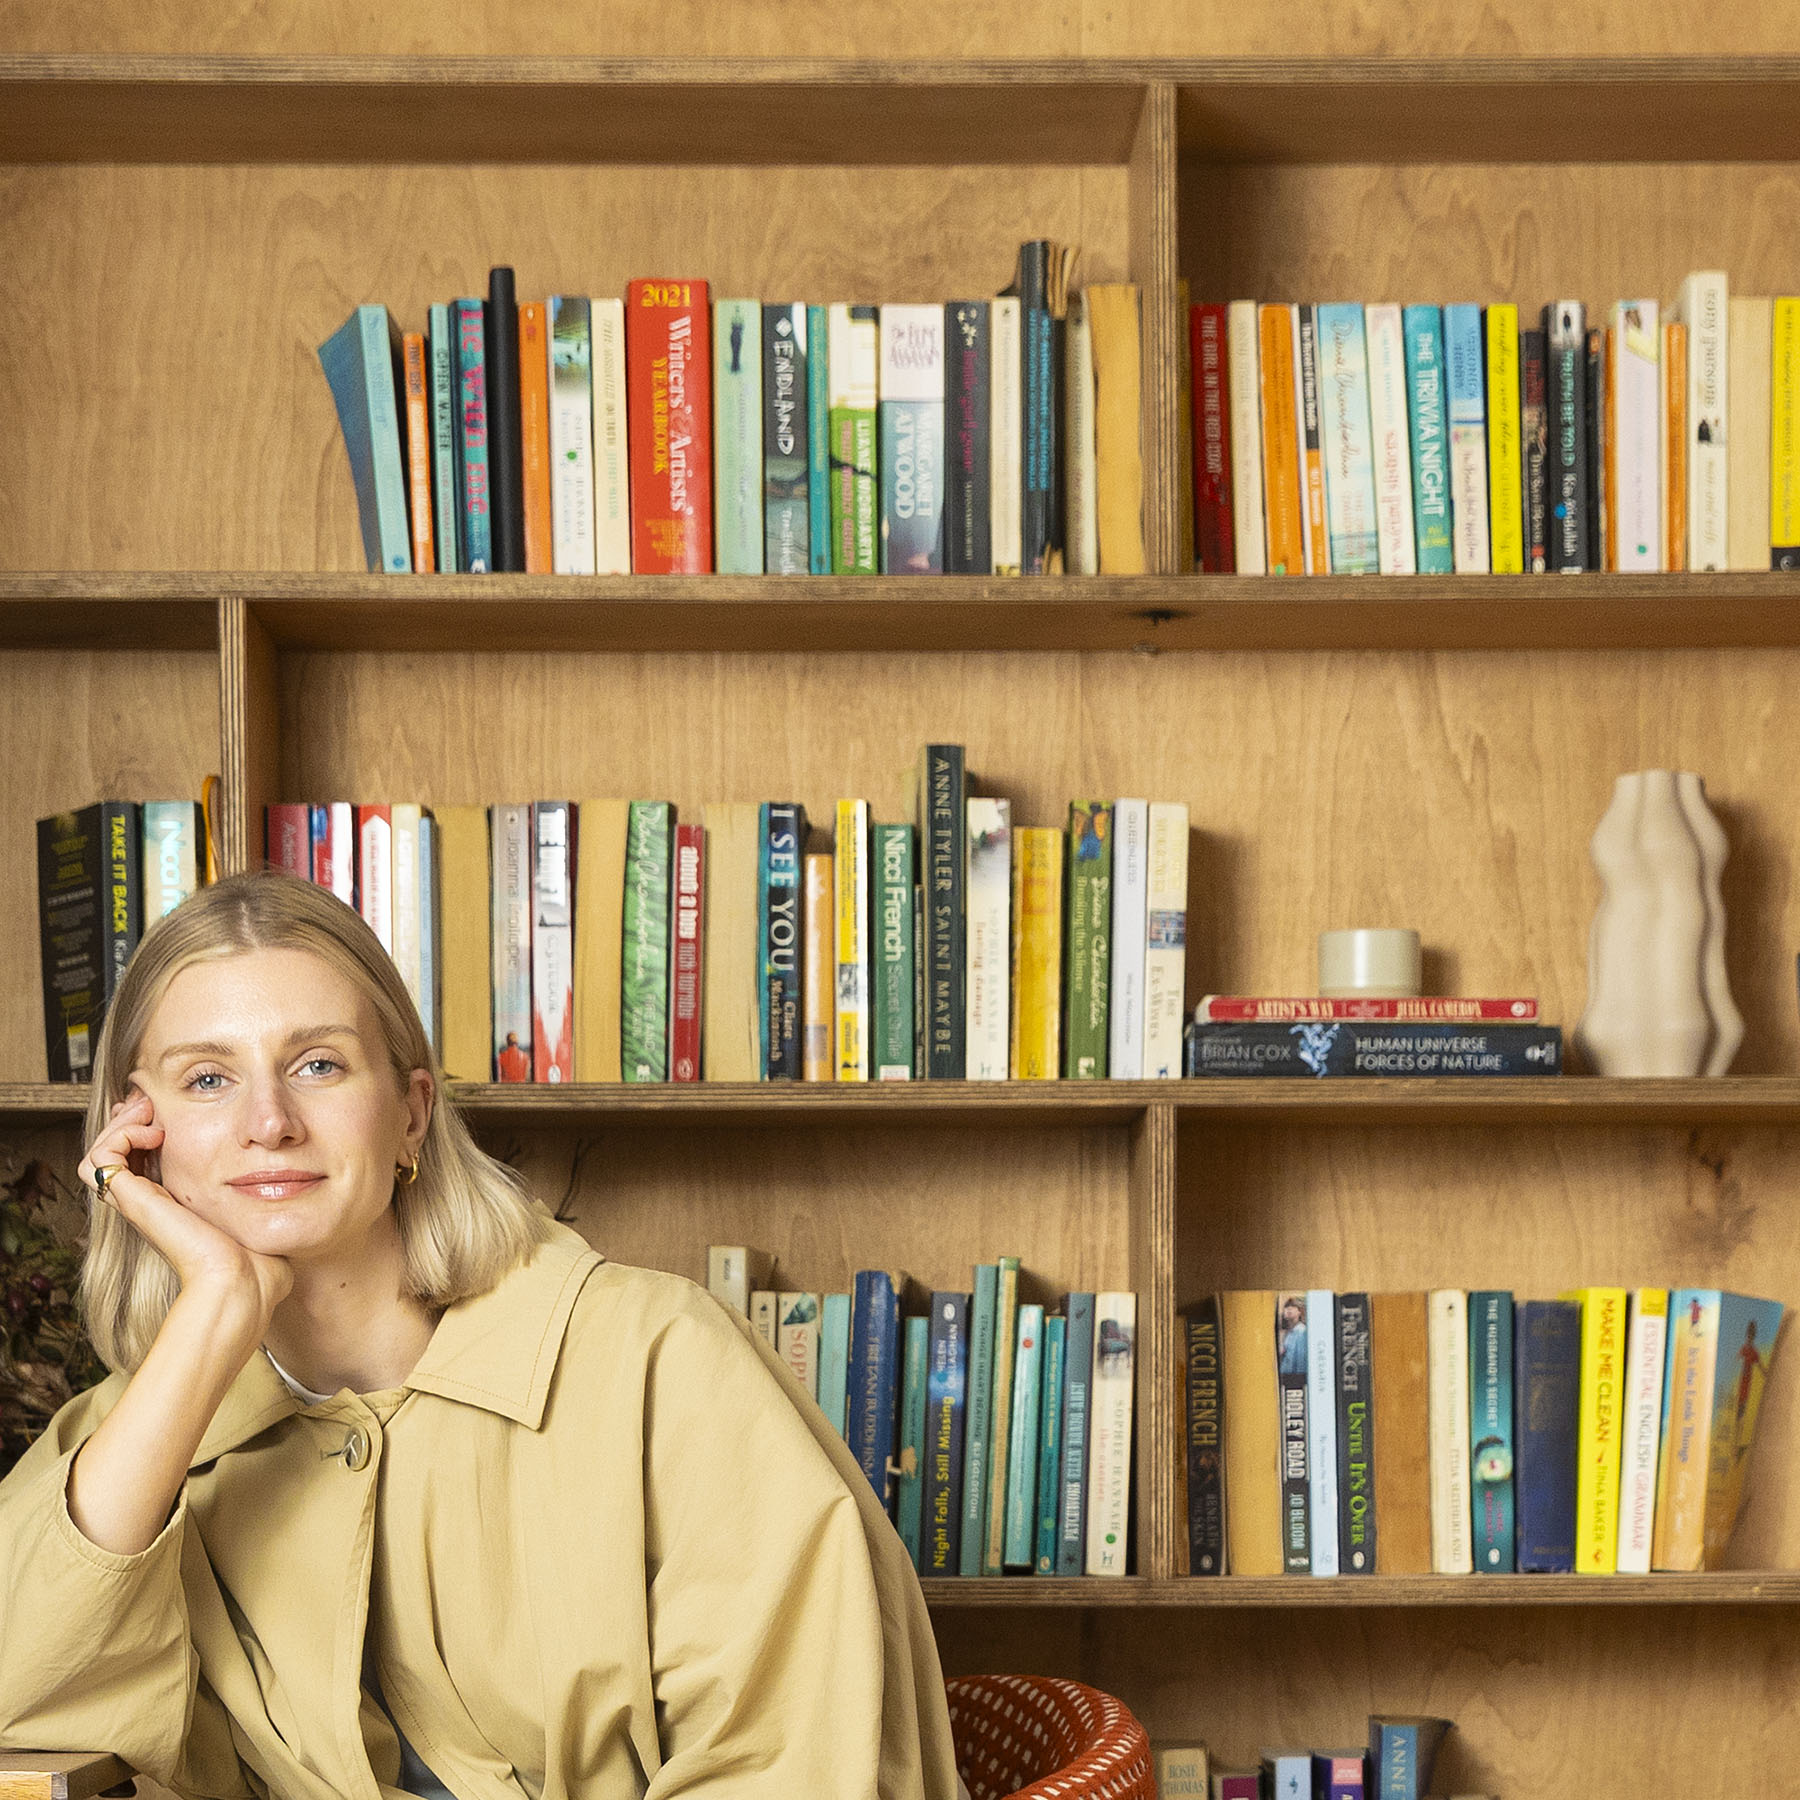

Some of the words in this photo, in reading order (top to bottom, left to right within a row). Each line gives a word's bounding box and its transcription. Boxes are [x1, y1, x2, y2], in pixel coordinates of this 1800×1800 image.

[640, 284, 691, 307] 2021
[668, 315, 693, 415] Writers'
[1416, 332, 1434, 364] THE
[1559, 348, 1576, 401] TRUTH
[463, 364, 487, 449] with
[652, 356, 668, 476] YEARBOOK
[774, 339, 794, 456] ENDLAND
[1416, 366, 1440, 437] TRIVIA
[1560, 403, 1577, 423] BE
[894, 408, 915, 520] ATWOOD
[917, 410, 934, 518] MARGARET
[1560, 426, 1576, 467] TOLD
[466, 463, 489, 515] me
[668, 432, 694, 518] Artists'
[1419, 439, 1445, 518] NIGHT
[772, 808, 795, 819] I
[934, 757, 953, 820] ANNE
[111, 814, 127, 860] TAKE
[770, 832, 795, 888] SEE
[884, 829, 907, 883] Nicci
[934, 828, 953, 893] TYLER
[112, 863, 127, 881] IT
[679, 845, 699, 894] about
[112, 884, 128, 933] BACK
[678, 909, 698, 940] boy
[679, 895, 697, 909] a
[884, 886, 907, 962] French
[770, 897, 796, 972] YOU
[935, 904, 952, 973] SAINT
[934, 979, 951, 1055] MAYBE
[1253, 1044, 1292, 1061] COX
[1355, 1037, 1414, 1052] HUMAN
[1415, 1037, 1488, 1052] UNIVERSE
[1355, 1054, 1415, 1070] FORCES
[1416, 1054, 1440, 1070] OF
[1442, 1054, 1504, 1070] NATURE
[1487, 1298, 1499, 1320] THE
[1597, 1298, 1615, 1351] MAKE
[1190, 1322, 1217, 1374] NICCI
[1341, 1304, 1364, 1392] FRENCH
[1486, 1322, 1499, 1385] HUSBAND'S
[1597, 1353, 1614, 1380] ME
[1640, 1321, 1657, 1400] ESSENTIAL
[937, 1396, 956, 1450] Missing
[1191, 1378, 1218, 1447] FRENCH
[1286, 1388, 1305, 1438] RIDLEY
[1486, 1386, 1498, 1428] SECRET
[1595, 1381, 1612, 1443] CLEAN
[1287, 1440, 1307, 1480] ROAD
[1637, 1403, 1654, 1470] ENGLISH
[1677, 1425, 1696, 1463] Things
[936, 1453, 952, 1482] Still
[934, 1486, 951, 1525] Falls,
[1290, 1508, 1306, 1551] BLOOM
[1593, 1499, 1608, 1542] BAKER
[1631, 1471, 1647, 1551] GRAMMAR
[933, 1528, 951, 1569] Night
[1389, 1734, 1407, 1793] ANNE
